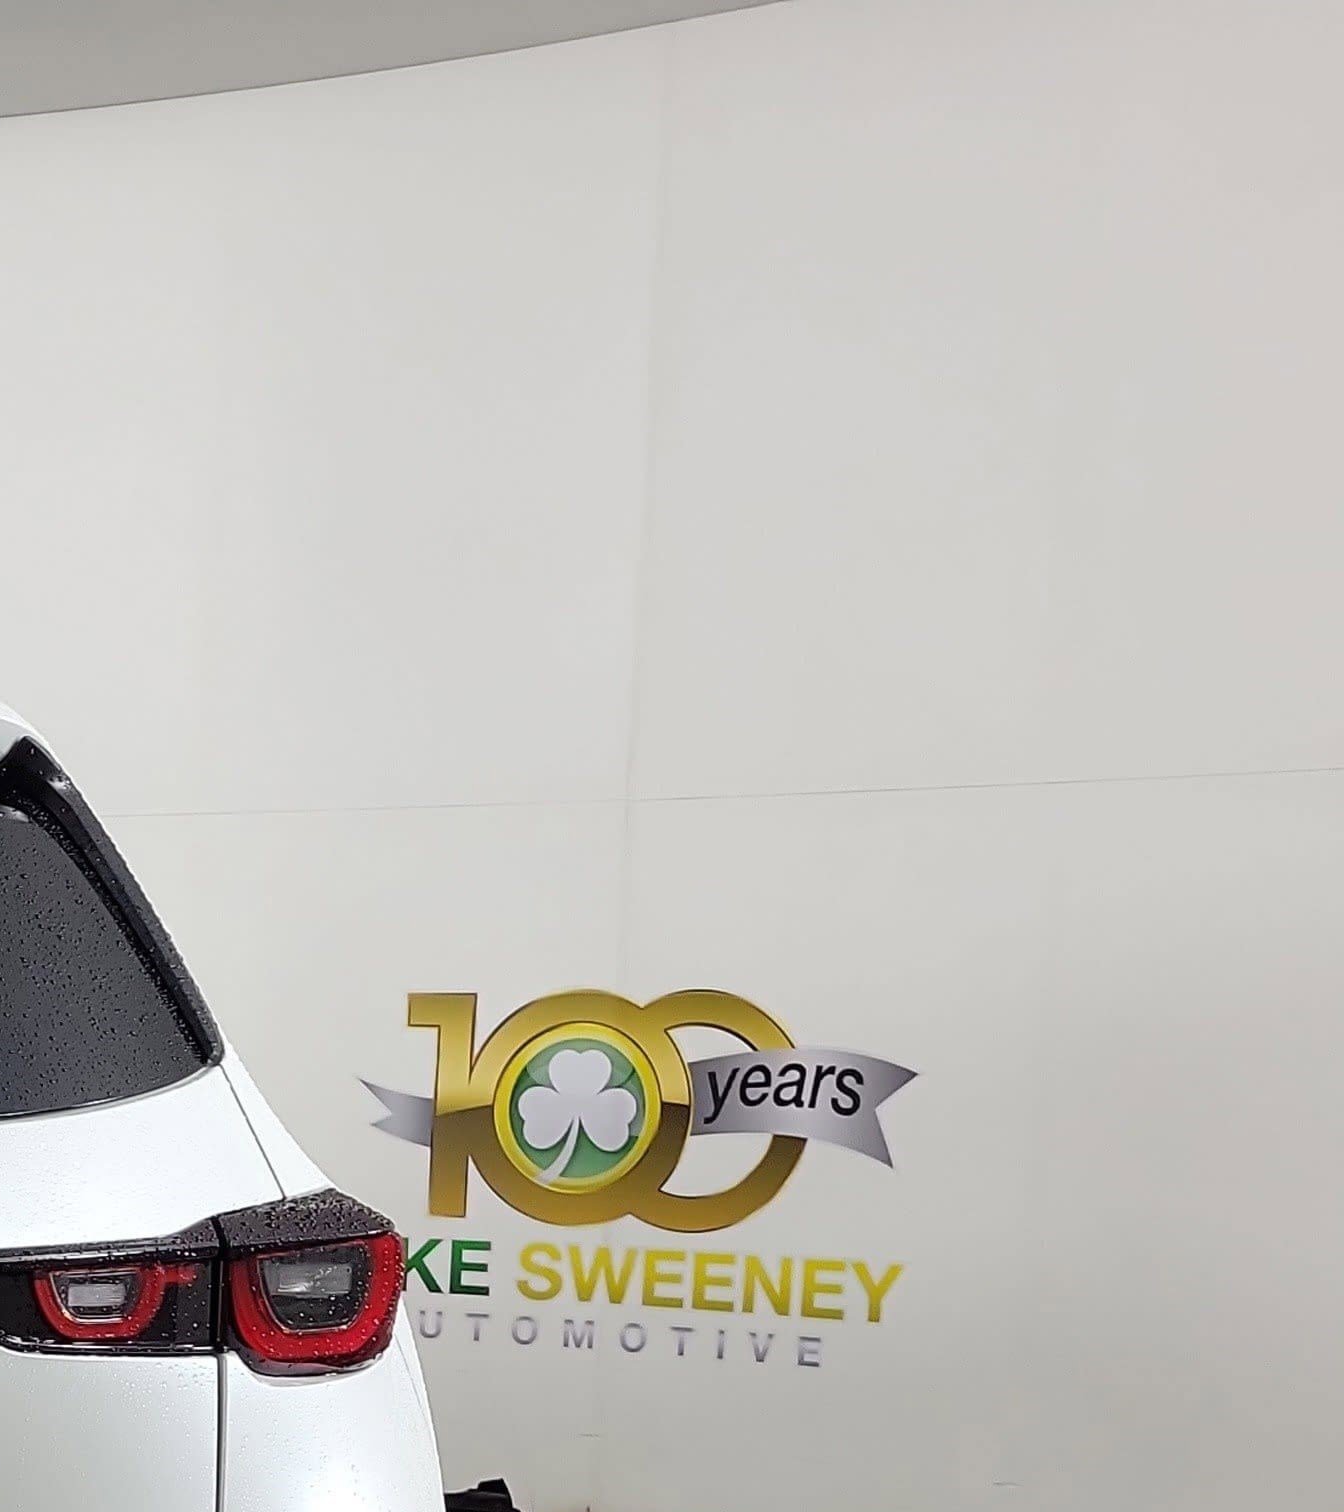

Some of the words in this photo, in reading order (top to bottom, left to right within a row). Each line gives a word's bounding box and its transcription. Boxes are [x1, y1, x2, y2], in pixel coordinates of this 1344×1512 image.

[407, 988, 808, 1234] 100
[703, 1062, 865, 1125] years
[402, 1236, 492, 1296] KE
[516, 1240, 906, 1323] SWEENEY
[419, 1309, 823, 1368] UTOMOTIVE
